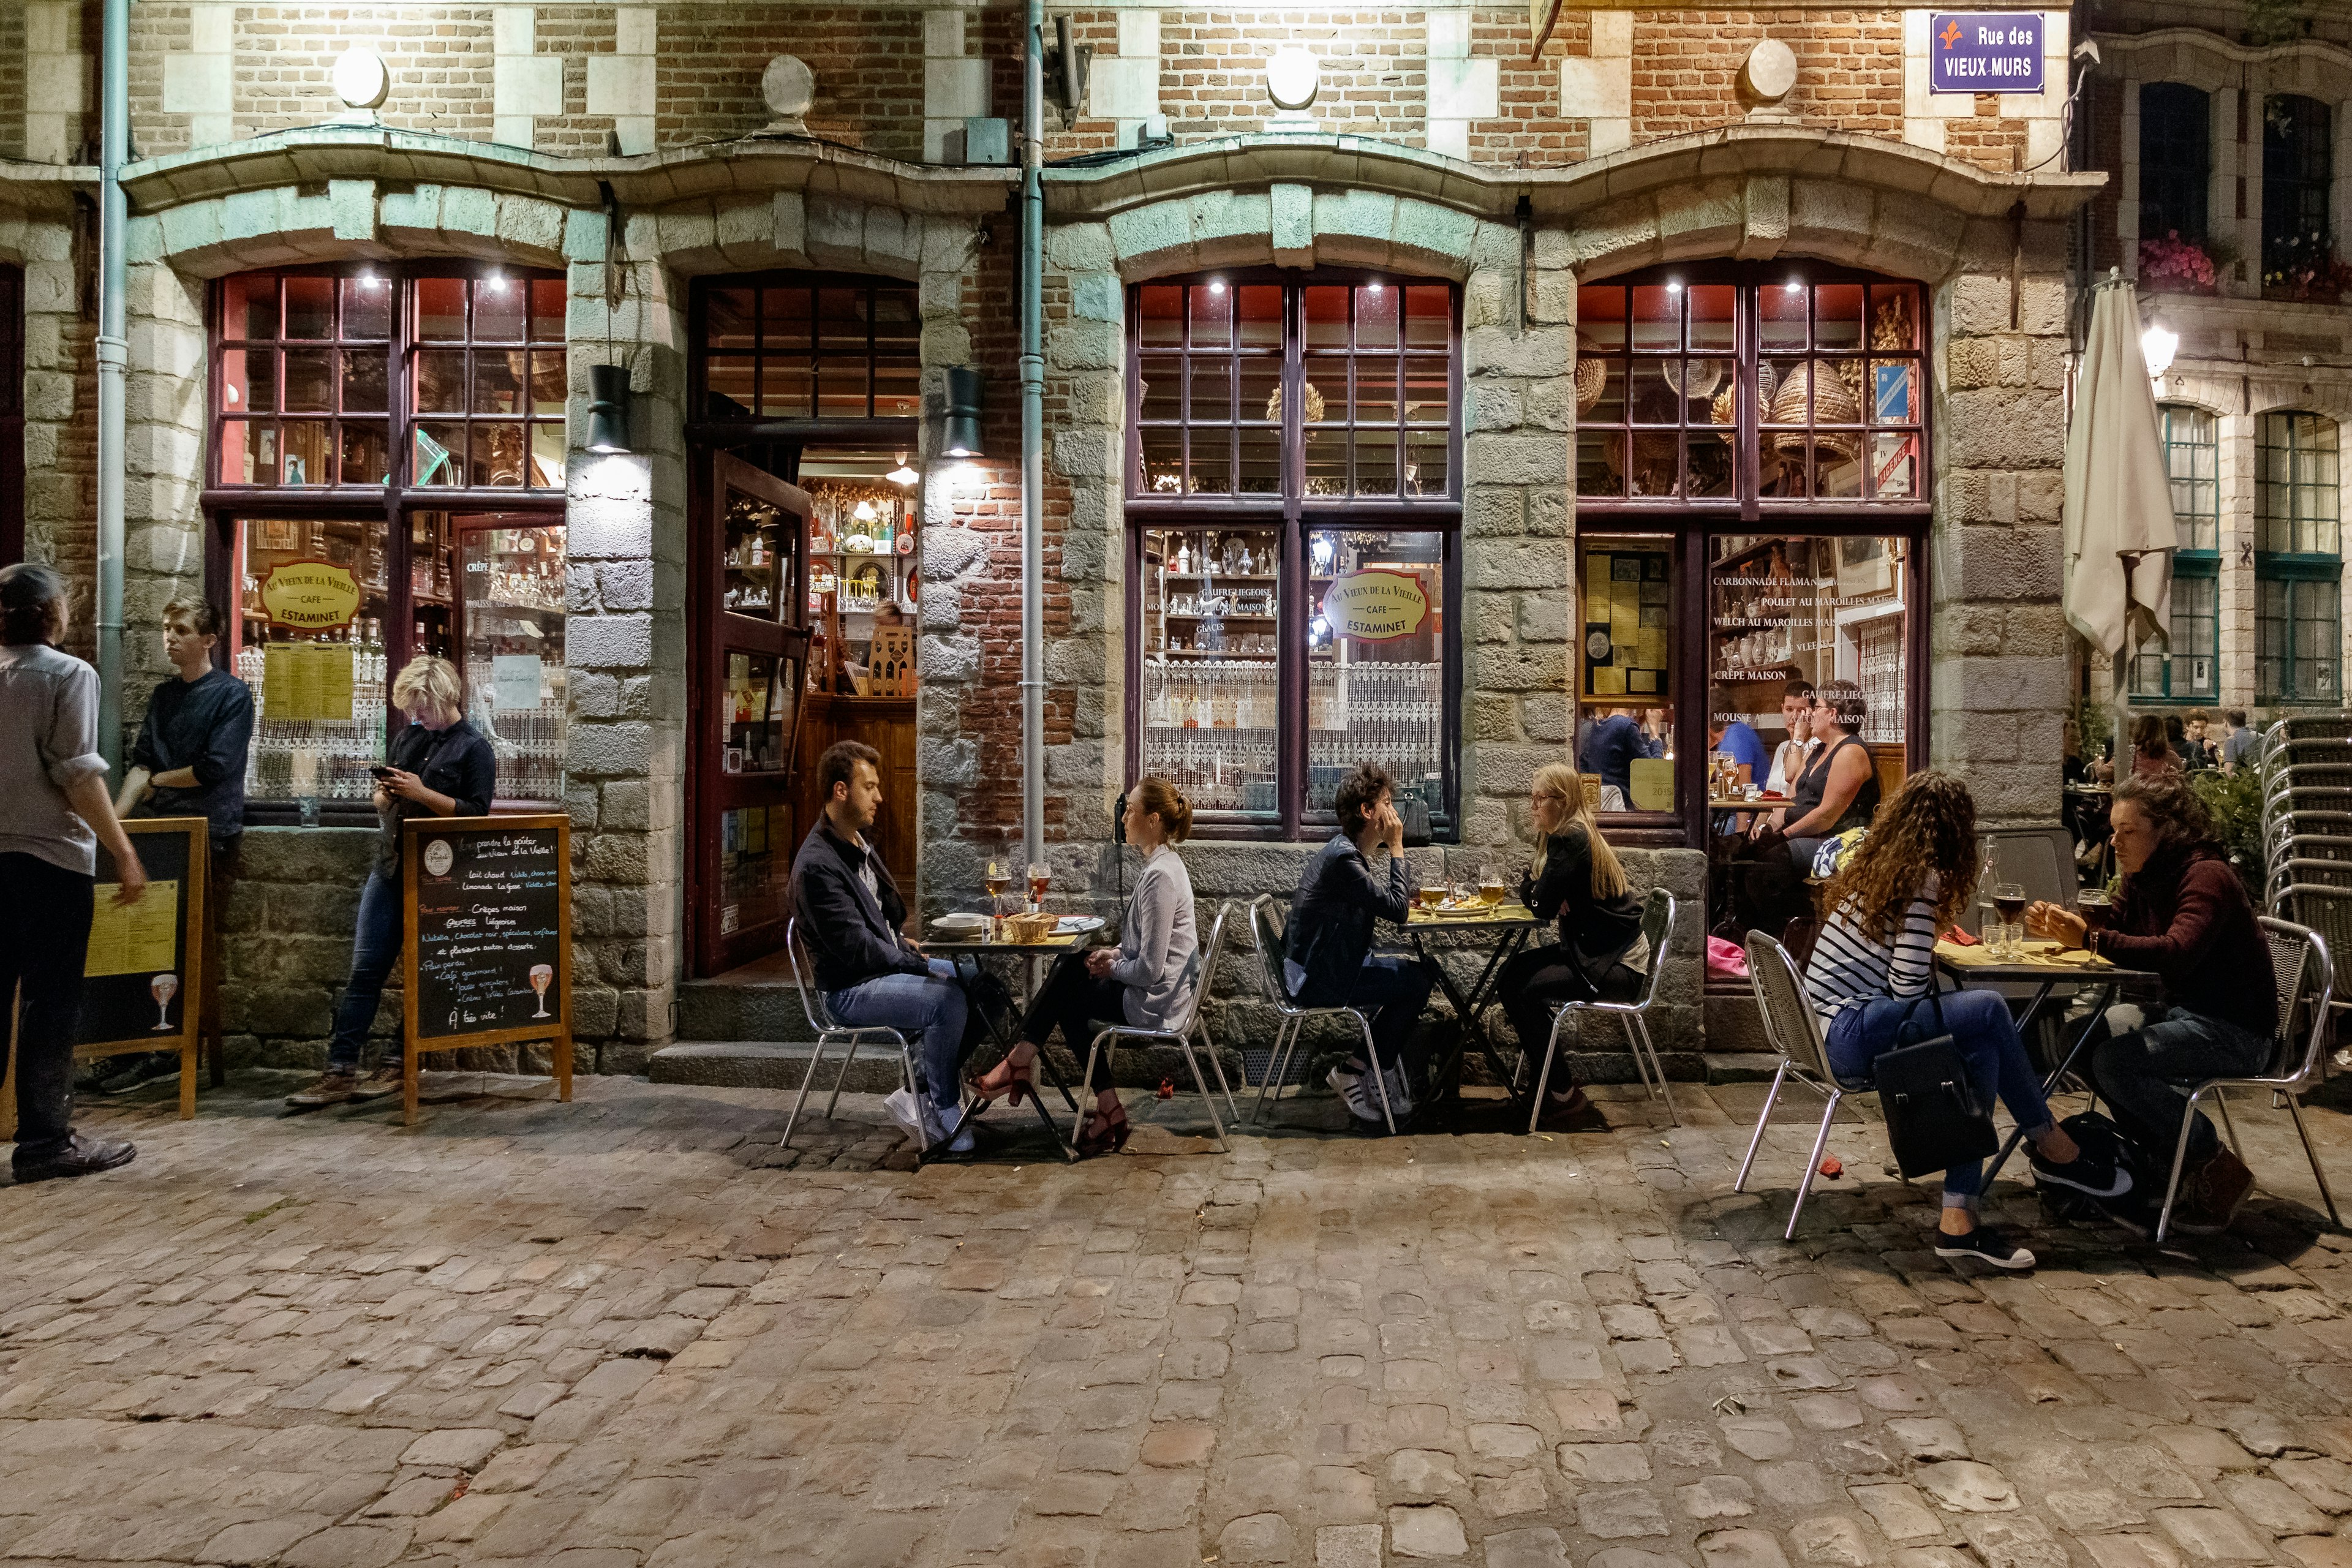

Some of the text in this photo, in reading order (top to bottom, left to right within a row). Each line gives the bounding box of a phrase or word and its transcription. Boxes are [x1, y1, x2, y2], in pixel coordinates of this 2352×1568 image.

[1978, 26, 2033, 45] Rue des
[1945, 57, 2032, 77] VIEUX MURS
[1879, 444, 1907, 485] LICENCE
[467, 560, 489, 573] CRÊPE
[277, 576, 303, 587] VIEUX
[303, 576, 313, 585] DE
[315, 576, 326, 586] LA
[328, 576, 356, 595] VIEILLE
[1713, 577, 1777, 586] CARBONNADE
[1235, 588, 1272, 597] LIEGEOISE
[1331, 586, 1423, 605] AU VIEUX DE LA VIEILLE
[300, 595, 322, 604] CAFE
[1762, 596, 1903, 606] POULET AU MAROILLES MAISON
[1236, 603, 1268, 611] MAISON
[1366, 605, 1387, 614] CAFE
[281, 609, 340, 623] ESTAMINET
[1196, 622, 1225, 633] GLACES
[1347, 619, 1406, 633] ESTAMINET
[1713, 617, 1852, 627] WELCH AU MAROILLES MAISON
[1715, 668, 1787, 680] CRÊPE MAISON
[1801, 690, 1841, 699] GAUFRE
[1713, 712, 1752, 723] MOUSSE
[1652, 788, 1673, 796] 2015
[503, 835, 512, 846] le
[484, 870, 505, 879] chaud
[450, 944, 481, 959] plusieurs
[480, 1011, 497, 1021] vite
